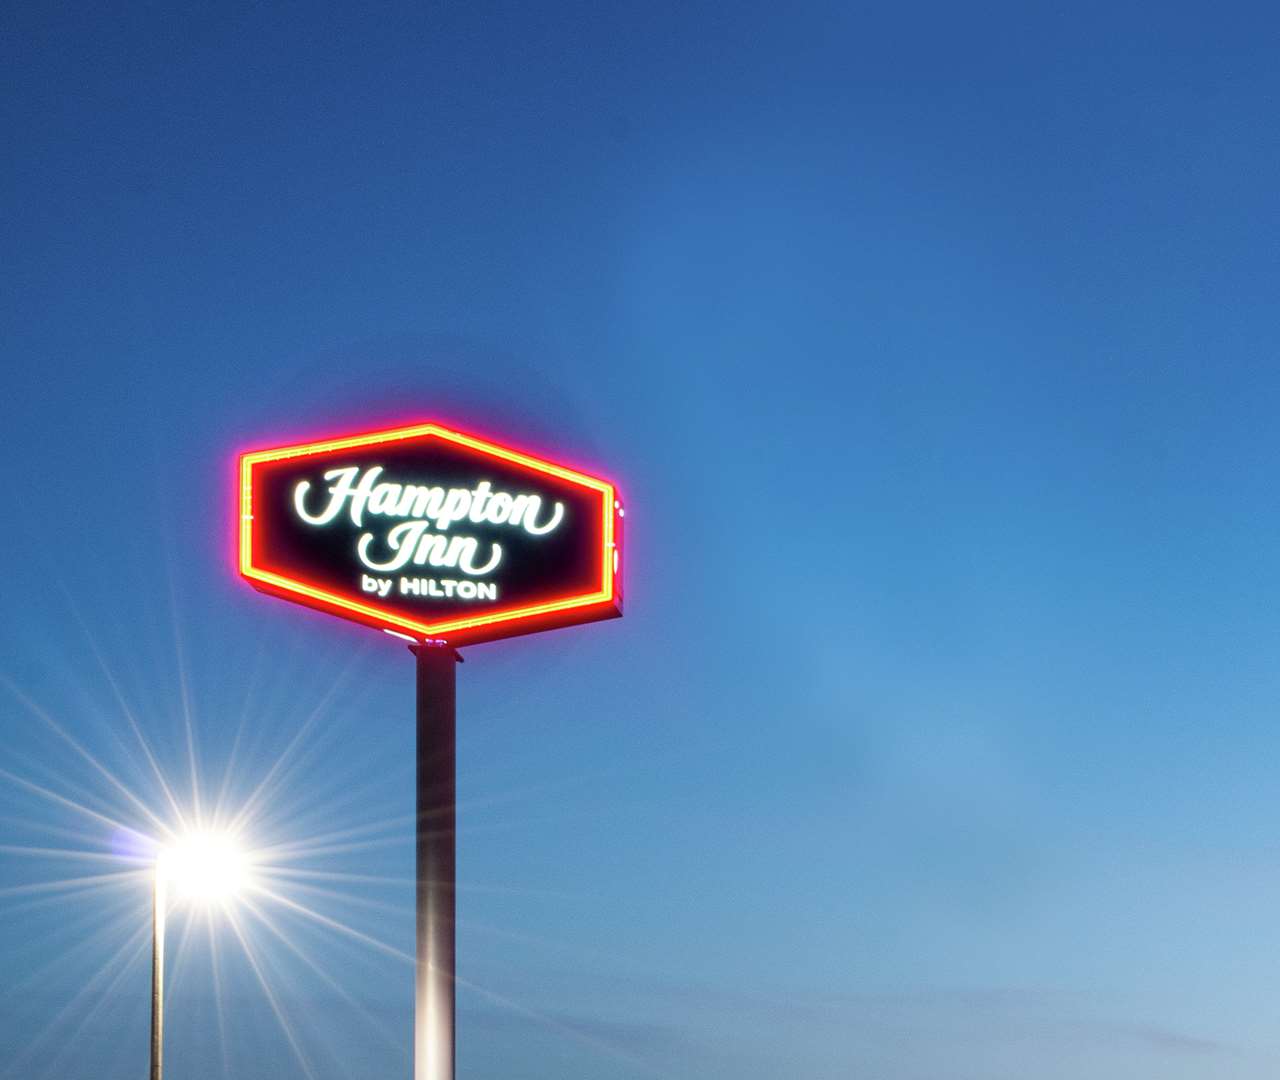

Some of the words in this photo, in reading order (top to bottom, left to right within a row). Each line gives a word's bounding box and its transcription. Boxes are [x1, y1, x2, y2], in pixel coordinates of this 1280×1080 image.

[294, 466, 564, 535] Hampton
[358, 520, 502, 575] Inn
[362, 574, 392, 597] by
[400, 577, 497, 600] HILTON
